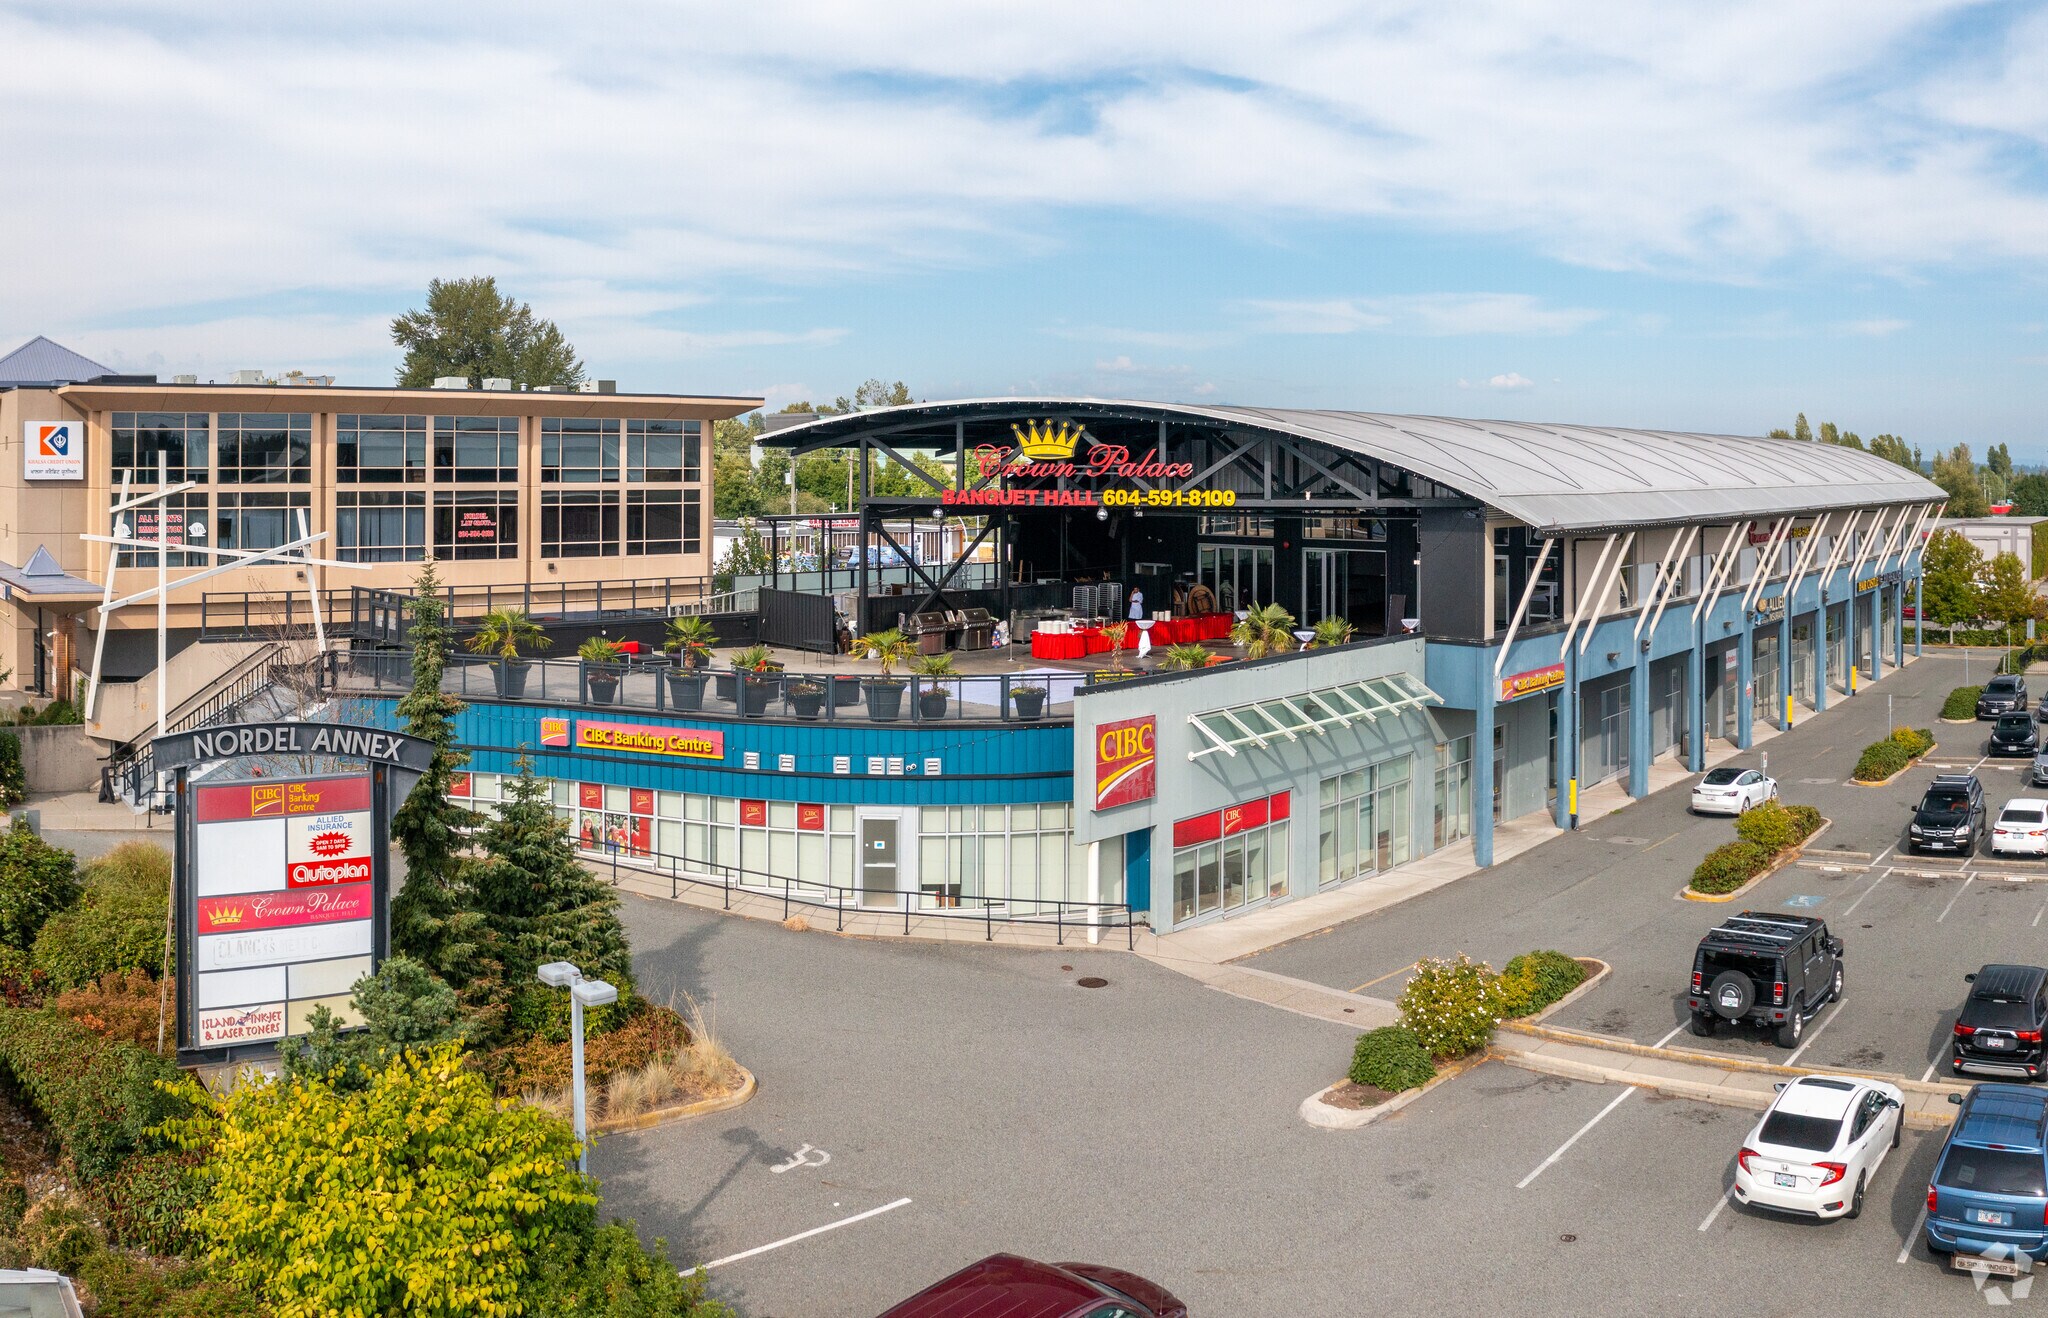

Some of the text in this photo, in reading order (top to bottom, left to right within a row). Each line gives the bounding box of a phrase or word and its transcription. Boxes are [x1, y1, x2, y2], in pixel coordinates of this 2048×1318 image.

[975, 443, 1194, 480] Crown Palace
[942, 489, 1236, 507] BANQUET HALL 604-591-8100
[138, 514, 182, 523] ALL PNTS
[138, 525, 183, 534] IMMIGTION
[542, 721, 565, 733] CIBC
[193, 727, 404, 761] NORDEL ANNEX
[583, 728, 712, 753] CIBC Banking Centre
[1100, 723, 1153, 762] CIBC
[255, 788, 281, 800] CIBC
[288, 783, 307, 793] CIBC
[288, 803, 315, 812] Centre
[316, 815, 344, 824] ALLIED
[1225, 808, 1242, 821] CIBC
[307, 822, 353, 831] INSURANCE
[252, 892, 360, 919] Crown Palace
[202, 1016, 235, 1029] ISLAND
[205, 1023, 280, 1040] & LASER TONERS
